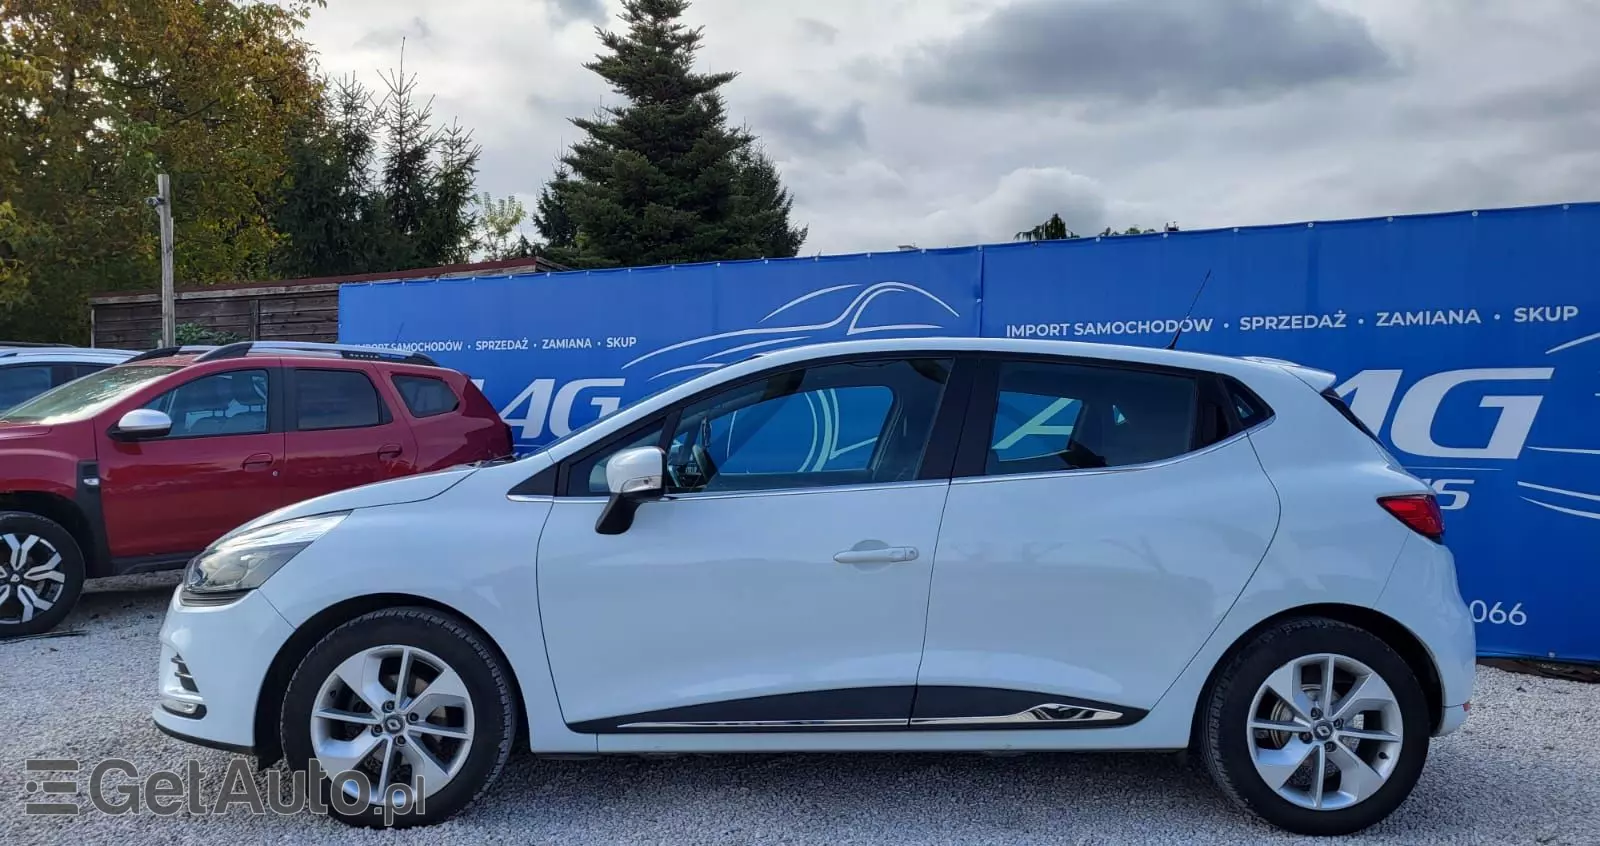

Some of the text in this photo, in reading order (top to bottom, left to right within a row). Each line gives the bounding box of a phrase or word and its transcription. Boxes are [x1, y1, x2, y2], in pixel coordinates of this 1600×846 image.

[1006, 305, 1579, 338] IMPORT SAMOCHODÓW SPRZEDAŻ ZAMIANA SKUP
[391, 340, 463, 353] SAMOCHODÓW
[475, 337, 529, 350] SPRZEDAŻ
[542, 338, 592, 349] ZAMIANA
[606, 337, 637, 348] SKUP
[470, 378, 626, 439] AG
[1469, 599, 1527, 626] 066
